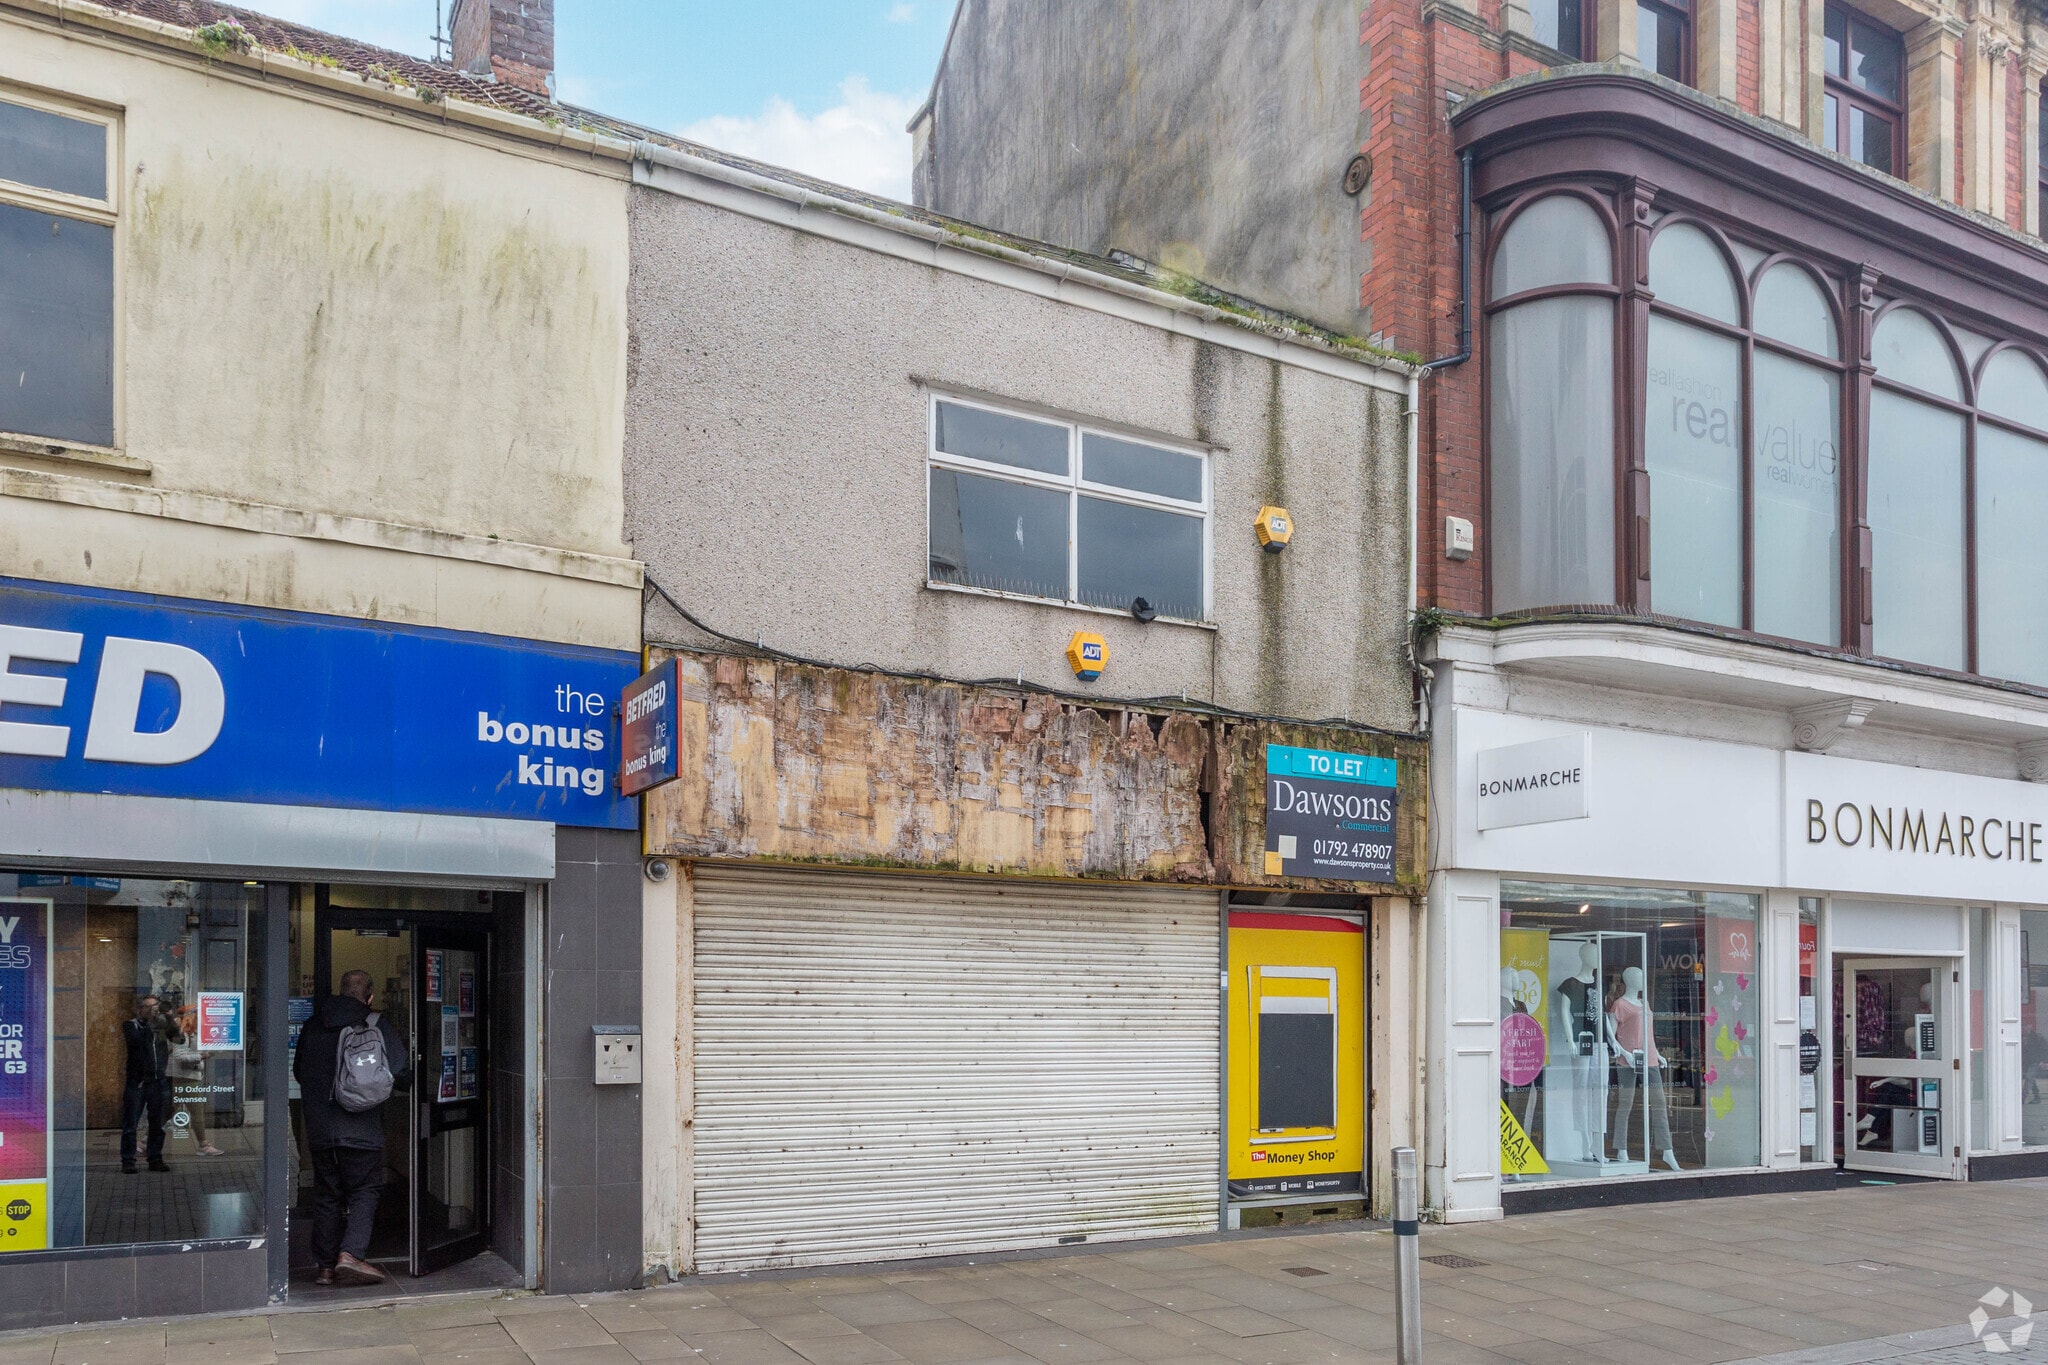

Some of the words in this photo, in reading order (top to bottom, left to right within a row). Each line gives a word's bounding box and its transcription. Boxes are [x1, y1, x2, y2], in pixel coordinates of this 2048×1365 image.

[1648, 367, 1721, 401] ealfashion
[1758, 419, 1837, 475] value
[1767, 464, 1838, 496] realwomen
[1271, 519, 1287, 530] ADT
[1083, 646, 1100, 658] ADT
[554, 683, 605, 716] the
[626, 680, 666, 725] BETFRED
[478, 711, 604, 752] bonus
[655, 720, 667, 740] the
[625, 755, 647, 776] bonus
[649, 744, 667, 765] king
[1308, 755, 1330, 773] TO
[1334, 758, 1363, 777] LET
[518, 754, 604, 796] king
[1480, 767, 1581, 797] BONMARCHE
[1273, 780, 1391, 822] Dawsons
[1341, 819, 1390, 833] Commercial
[1807, 799, 2043, 864] BONMARCHE
[1313, 839, 1348, 857] 01792
[1351, 843, 1393, 860] 478907
[1313, 858, 1391, 870] www.dawsonsproperty.co.uk
[1507, 1038, 1532, 1047] START
[1508, 1028, 1537, 1037] FRESH
[4, 1060, 27, 1074] 63
[185, 1085, 211, 1093] Oxford
[212, 1085, 235, 1093] Street
[1252, 1152, 1265, 1160] The
[1267, 1152, 1304, 1164] Money
[1308, 1150, 1335, 1163] Shop
[8, 1205, 30, 1215] STOP
